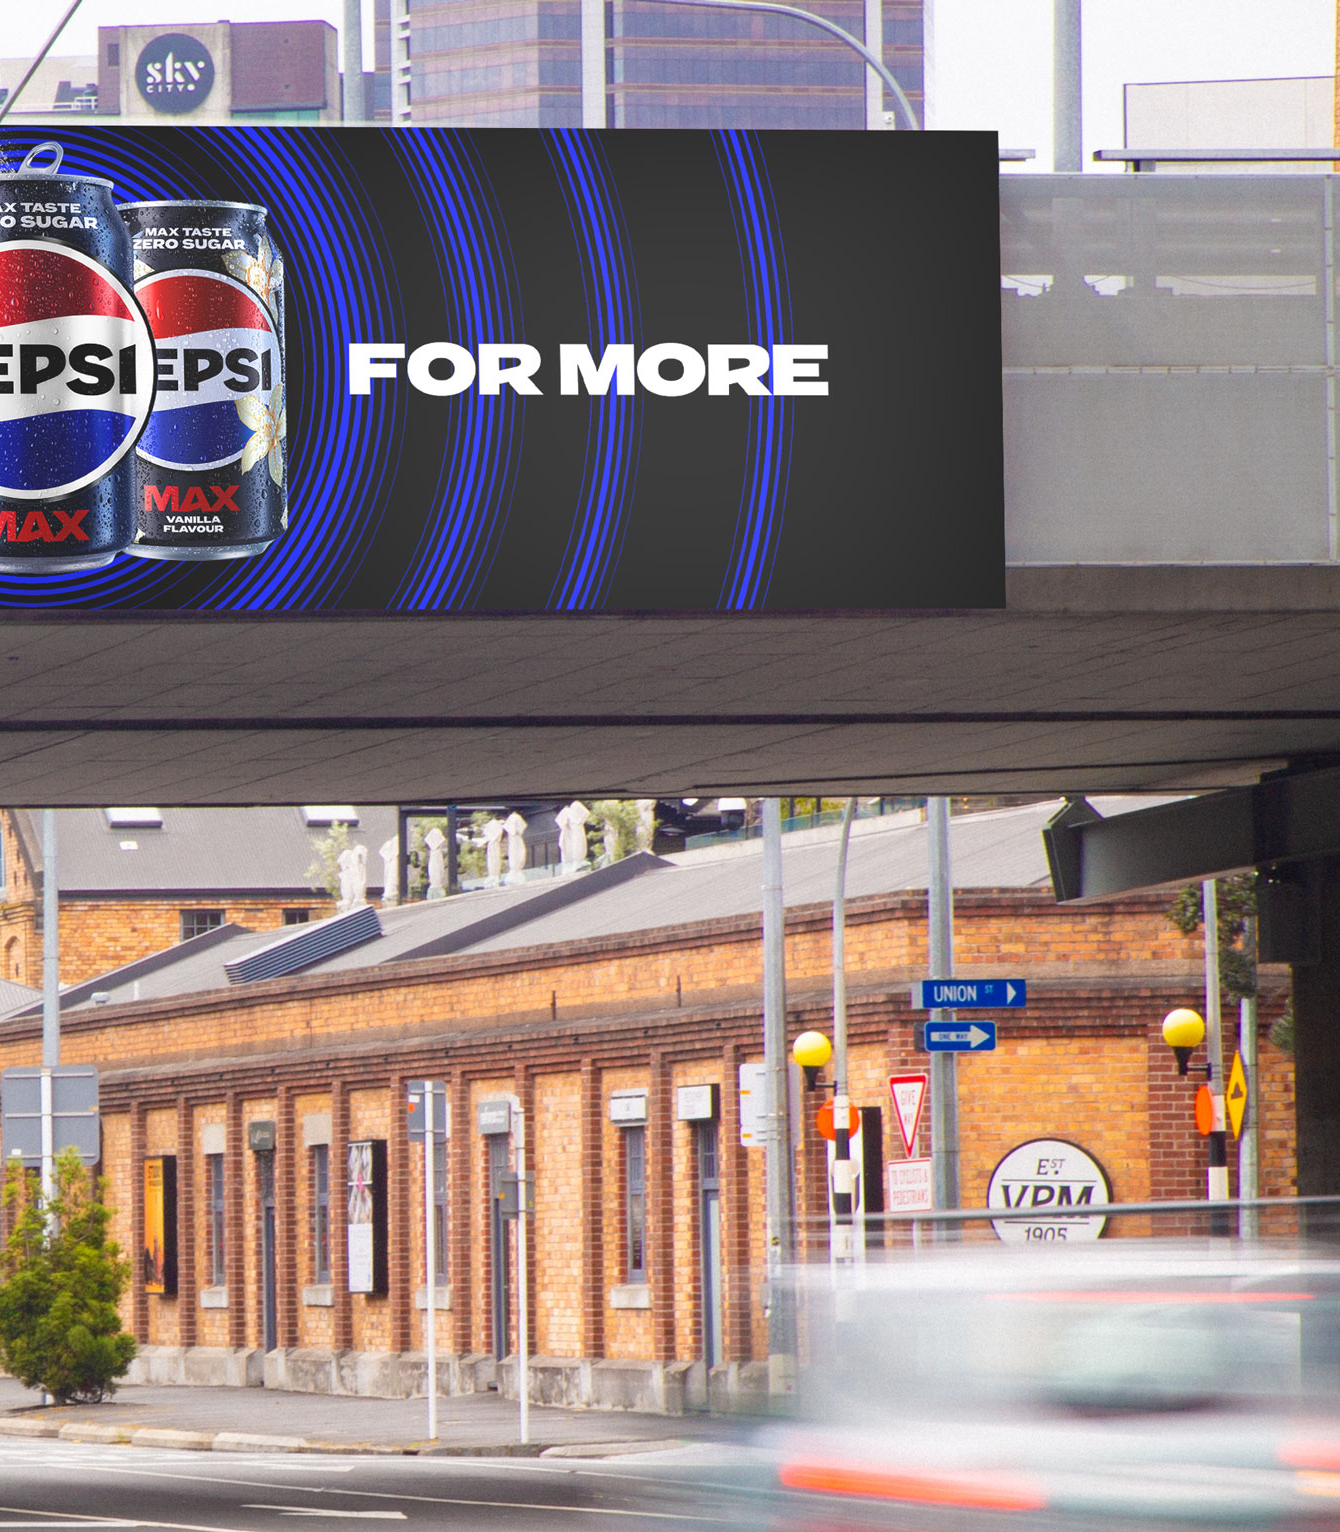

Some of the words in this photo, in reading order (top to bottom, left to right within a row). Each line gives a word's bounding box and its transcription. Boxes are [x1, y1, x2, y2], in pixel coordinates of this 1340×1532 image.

[146, 51, 205, 84] sky
[146, 84, 185, 93] CITY
[20, 203, 82, 213] TASTE
[20, 216, 98, 230] SUGAR
[145, 227, 179, 237] MAX
[182, 227, 232, 237] TASTE
[133, 238, 179, 249] ZERO
[182, 238, 246, 250] SUGAR
[156, 348, 272, 392] EPSI
[348, 341, 544, 397] FOR
[559, 342, 830, 398] MORE
[144, 485, 241, 512] MAX
[166, 515, 221, 524] VANILLA
[163, 525, 224, 533] FLAVOUR
[933, 985, 977, 1002] UNION
[984, 985, 994, 994] ST
[900, 1089, 916, 1106] GIVE
[1024, 1227, 1068, 1241] 1905
